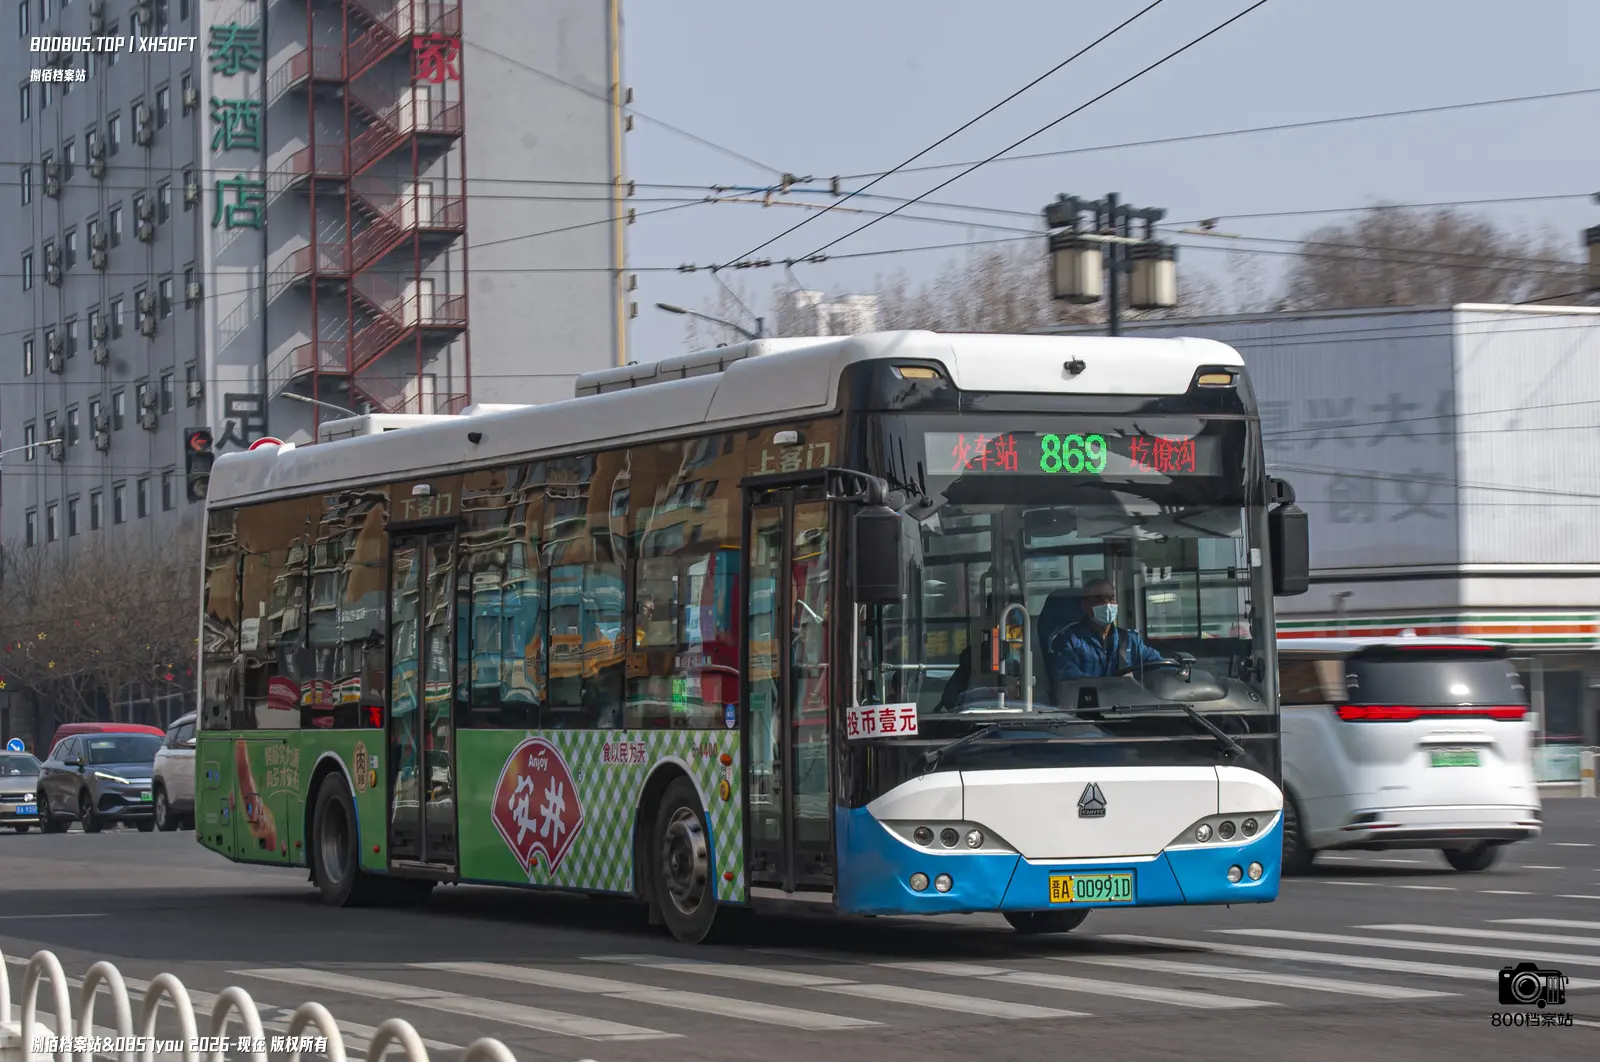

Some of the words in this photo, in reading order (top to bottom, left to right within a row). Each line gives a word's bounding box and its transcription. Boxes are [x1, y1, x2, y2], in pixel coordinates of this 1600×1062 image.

[413, 32, 461, 84] 家
[208, 20, 264, 230] 泰酒店
[215, 392, 267, 451] 足
[752, 442, 831, 476] 上客门
[951, 433, 1018, 472] 火车站
[1039, 433, 1108, 474] 869
[400, 493, 453, 520] 下客门
[847, 707, 917, 736] 投币壹元
[528, 754, 549, 772] Anjoy
[602, 742, 646, 764] 食以民为天
[508, 774, 567, 849] 安井
